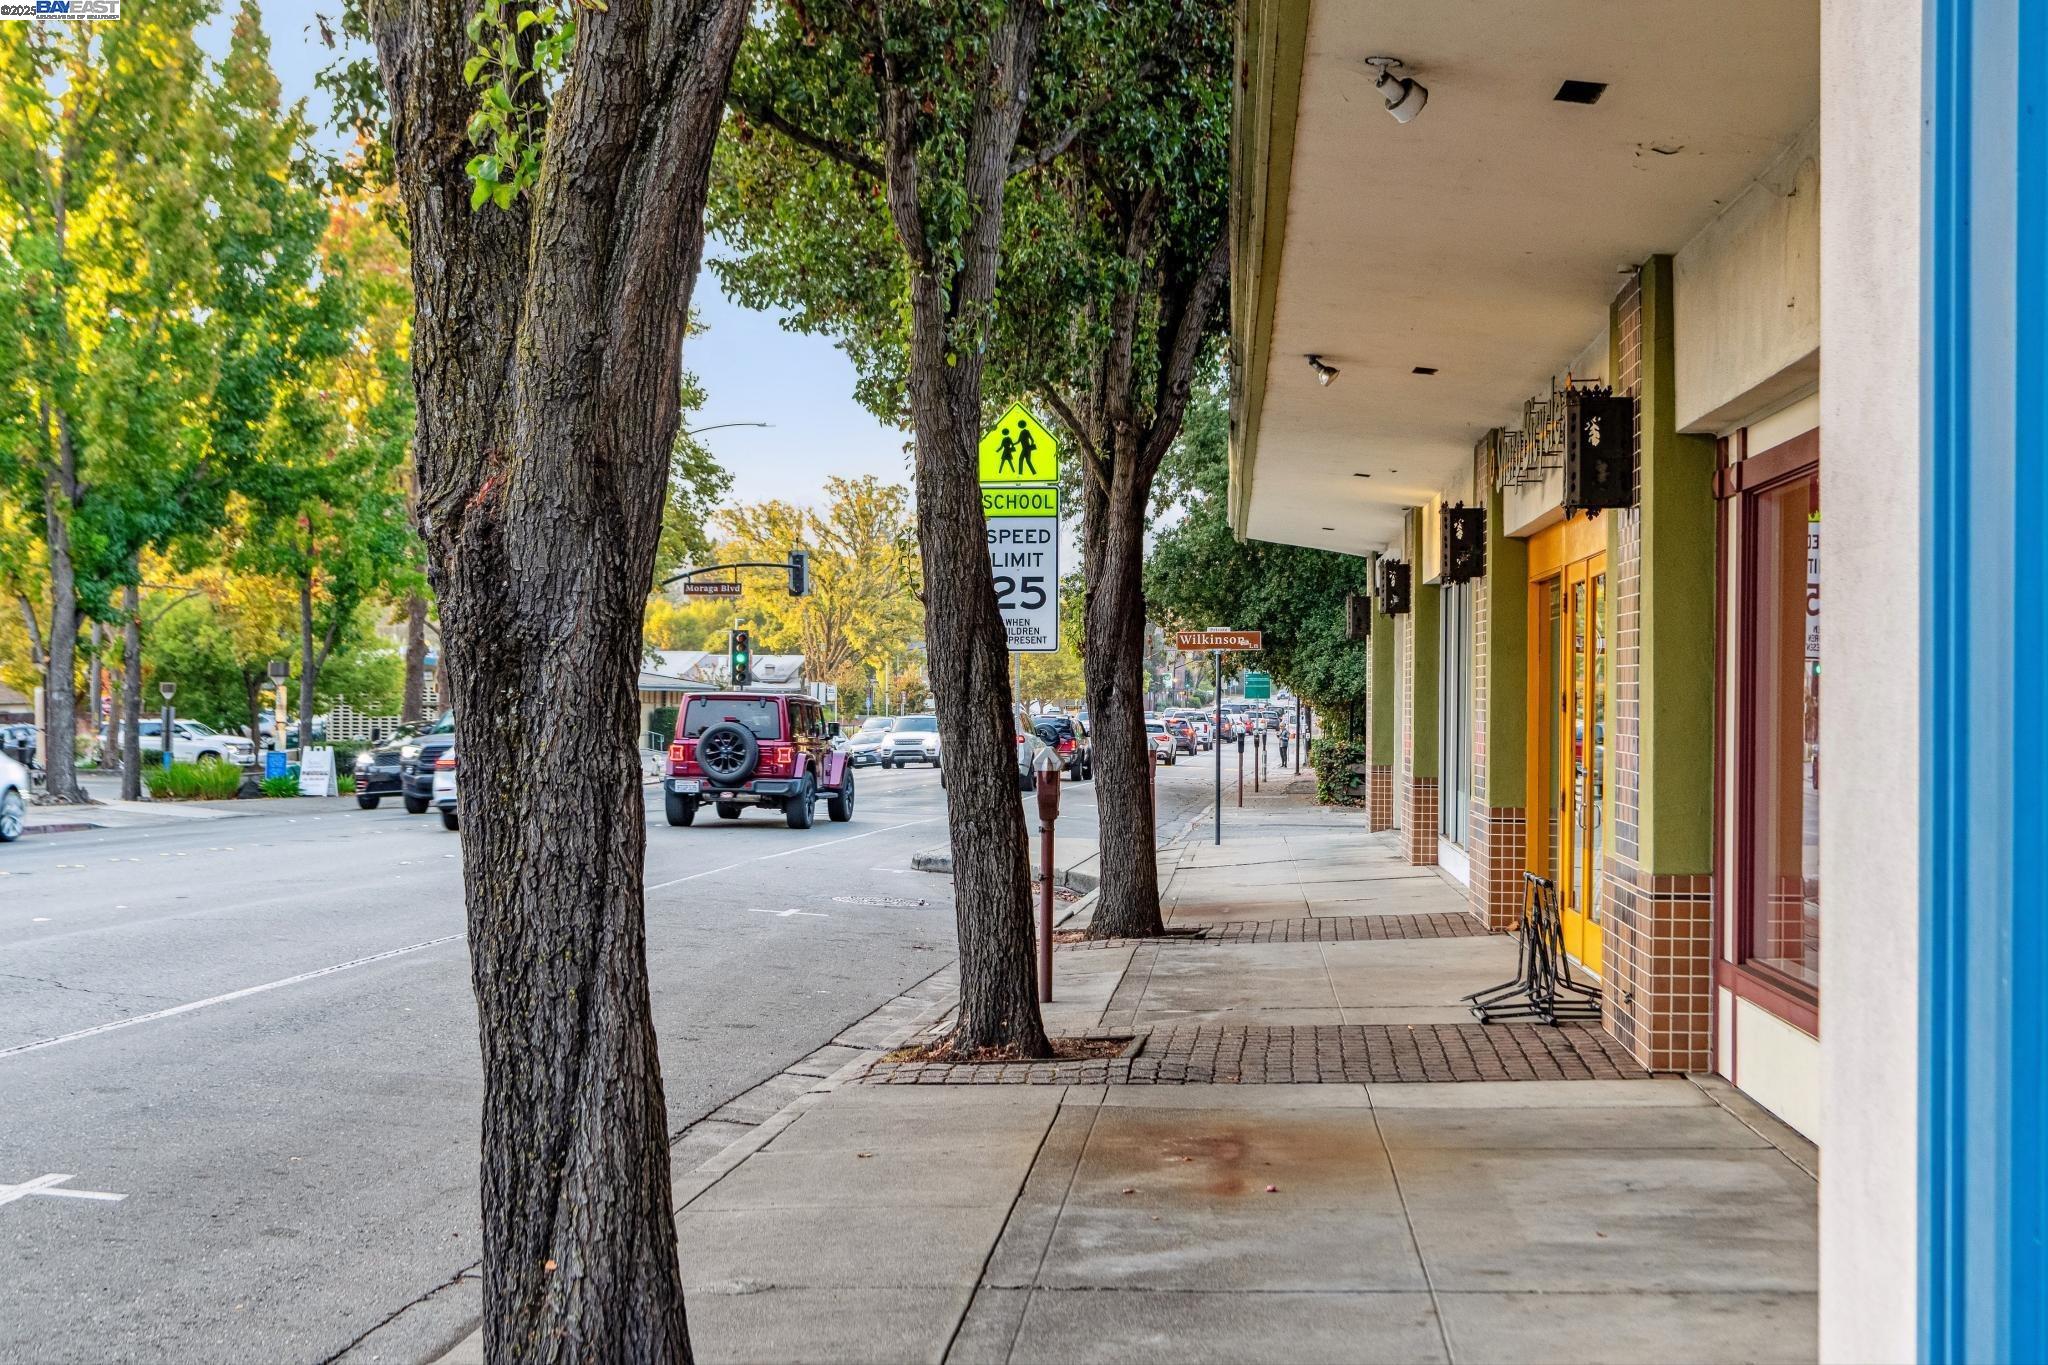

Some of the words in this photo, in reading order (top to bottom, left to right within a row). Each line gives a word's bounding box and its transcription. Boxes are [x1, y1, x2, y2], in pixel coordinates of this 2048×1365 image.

[983, 494, 1054, 510] SCHOOL
[986, 529, 1051, 544] SPEED
[992, 552, 1044, 568] LIMIT
[685, 584, 718, 593] Moraga
[720, 584, 740, 592] Blvd
[993, 575, 1047, 610] 25
[1005, 618, 1031, 627] WHEN
[1008, 627, 1040, 636] ILDREN
[1008, 636, 1047, 645] PRESENT
[1179, 633, 1245, 646] Wilkinson
